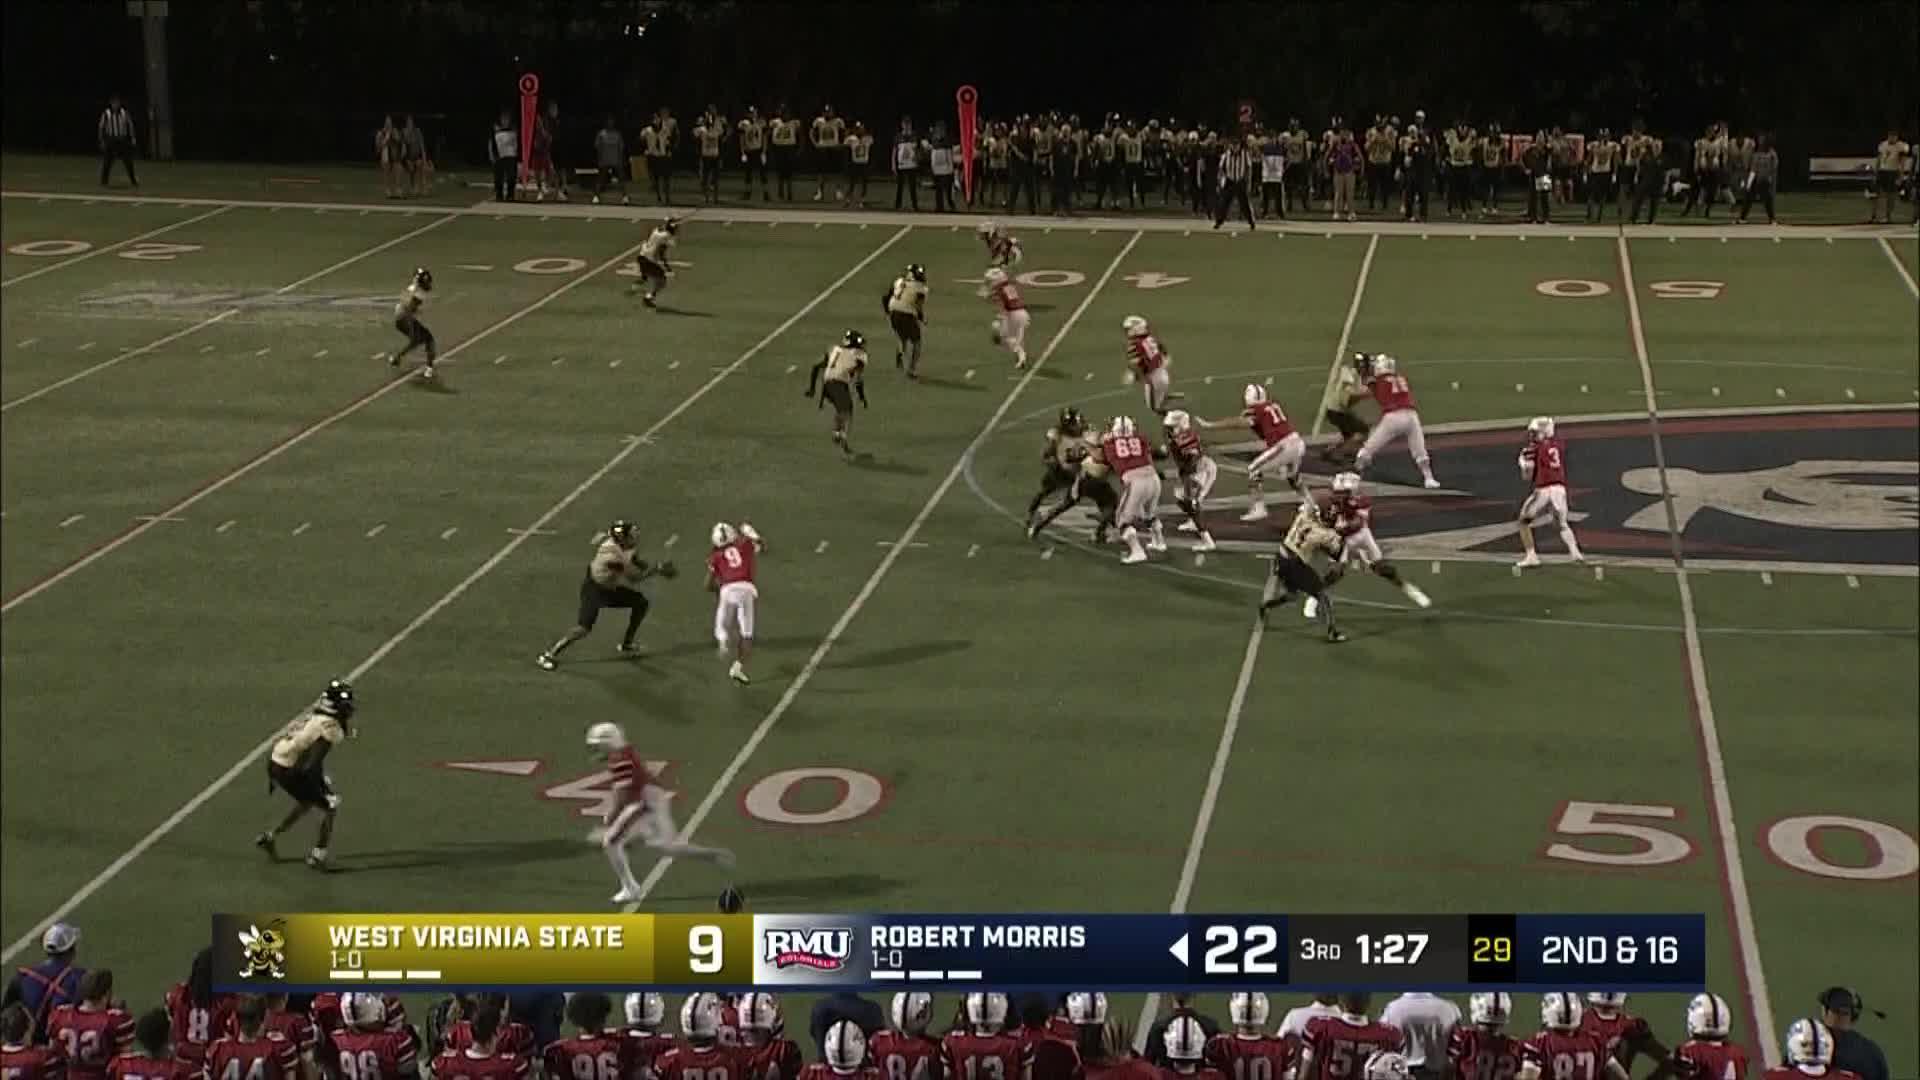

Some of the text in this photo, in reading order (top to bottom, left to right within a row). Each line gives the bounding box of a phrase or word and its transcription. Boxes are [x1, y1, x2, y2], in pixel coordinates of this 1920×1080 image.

[1115, 437, 1142, 459] 69
[1547, 447, 1562, 468] 3
[723, 546, 742, 568] 9
[1552, 1052, 1595, 1080] 87
